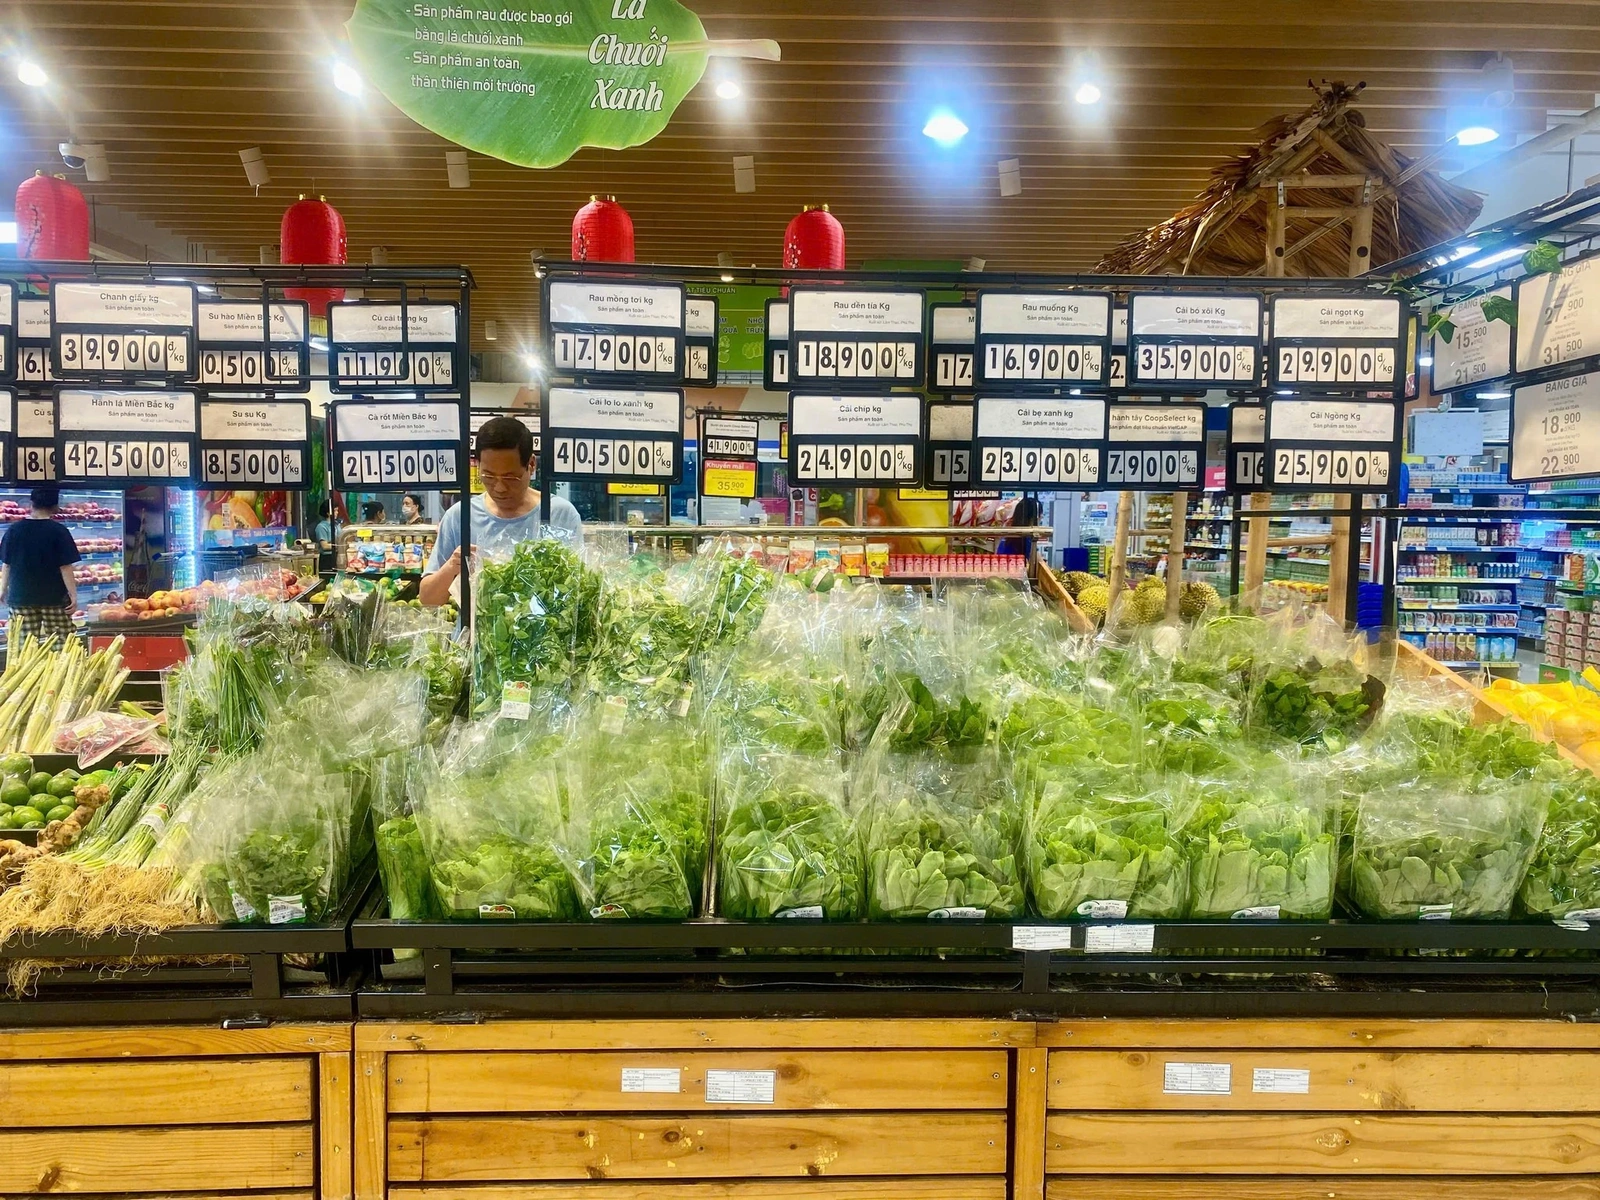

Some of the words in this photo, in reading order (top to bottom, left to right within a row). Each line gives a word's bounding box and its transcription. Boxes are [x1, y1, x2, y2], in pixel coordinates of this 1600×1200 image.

[414, 4, 437, 18] Sản
[441, 5, 472, 20] phẩm
[477, 10, 495, 20] rau
[500, 9, 527, 24] được
[531, 11, 551, 23] bao
[555, 11, 572, 26] gói
[415, 26, 444, 44] bằng
[448, 30, 457, 42] lá
[461, 30, 492, 44] chuối
[495, 34, 523, 45] xanh
[588, 26, 668, 67] Chuối
[413, 51, 437, 65] Sản
[440, 52, 472, 68] phẩm
[476, 58, 490, 67] an
[411, 74, 437, 88] thân
[441, 76, 469, 92] thiện
[473, 79, 493, 91] môi
[497, 80, 535, 96] trường
[590, 78, 664, 111] Xanh
[589, 294, 604, 302] Rau
[607, 294, 629, 304] mồng
[644, 297, 653, 305] kg
[851, 301, 865, 309] dền
[879, 302, 890, 311] Kg
[1039, 304, 1066, 313] muống
[1068, 305, 1079, 313] Kg
[274, 314, 284, 322] Kg
[419, 315, 428, 323] kg
[1215, 308, 1225, 316] Kg
[64, 338, 160, 363] 39.900
[561, 339, 651, 364] 17.900
[657, 342, 673, 364] đ/kg
[804, 345, 892, 370] 18.900
[898, 347, 913, 368] đ/kg
[990, 347, 1079, 372] 16.900
[1084, 351, 1099, 372] đ/kg
[1141, 348, 1231, 373] 35.900
[1236, 352, 1251, 371] đ/kg
[435, 357, 450, 377] đ/kg
[1282, 351, 1371, 375] 29.900
[1377, 352, 1392, 374] đ/kg
[92, 399, 113, 407] Hành
[116, 399, 122, 407] lá
[165, 400, 174, 410] kg
[232, 410, 242, 418] Su
[256, 411, 266, 419] Kg
[644, 400, 653, 409] kg
[873, 406, 881, 414] kg
[1064, 410, 1073, 418] kg
[428, 413, 437, 421] kg
[1351, 412, 1360, 421] Kg
[68, 444, 164, 469] 42.500
[171, 448, 188, 469] đ/kg
[284, 455, 299, 474] đ/kg
[347, 454, 434, 476] 21.500
[439, 455, 454, 475] đ/kg
[557, 442, 649, 468] 40.500
[656, 447, 671, 468] đ/kg
[801, 448, 891, 471] 24.900
[897, 450, 912, 471] đ/kg
[985, 451, 1076, 475] 23.900
[1082, 454, 1097, 473] đ/kg
[1182, 455, 1196, 475] đ/kg
[1279, 454, 1366, 478] 25.900
[1373, 456, 1387, 476] đ/kg
